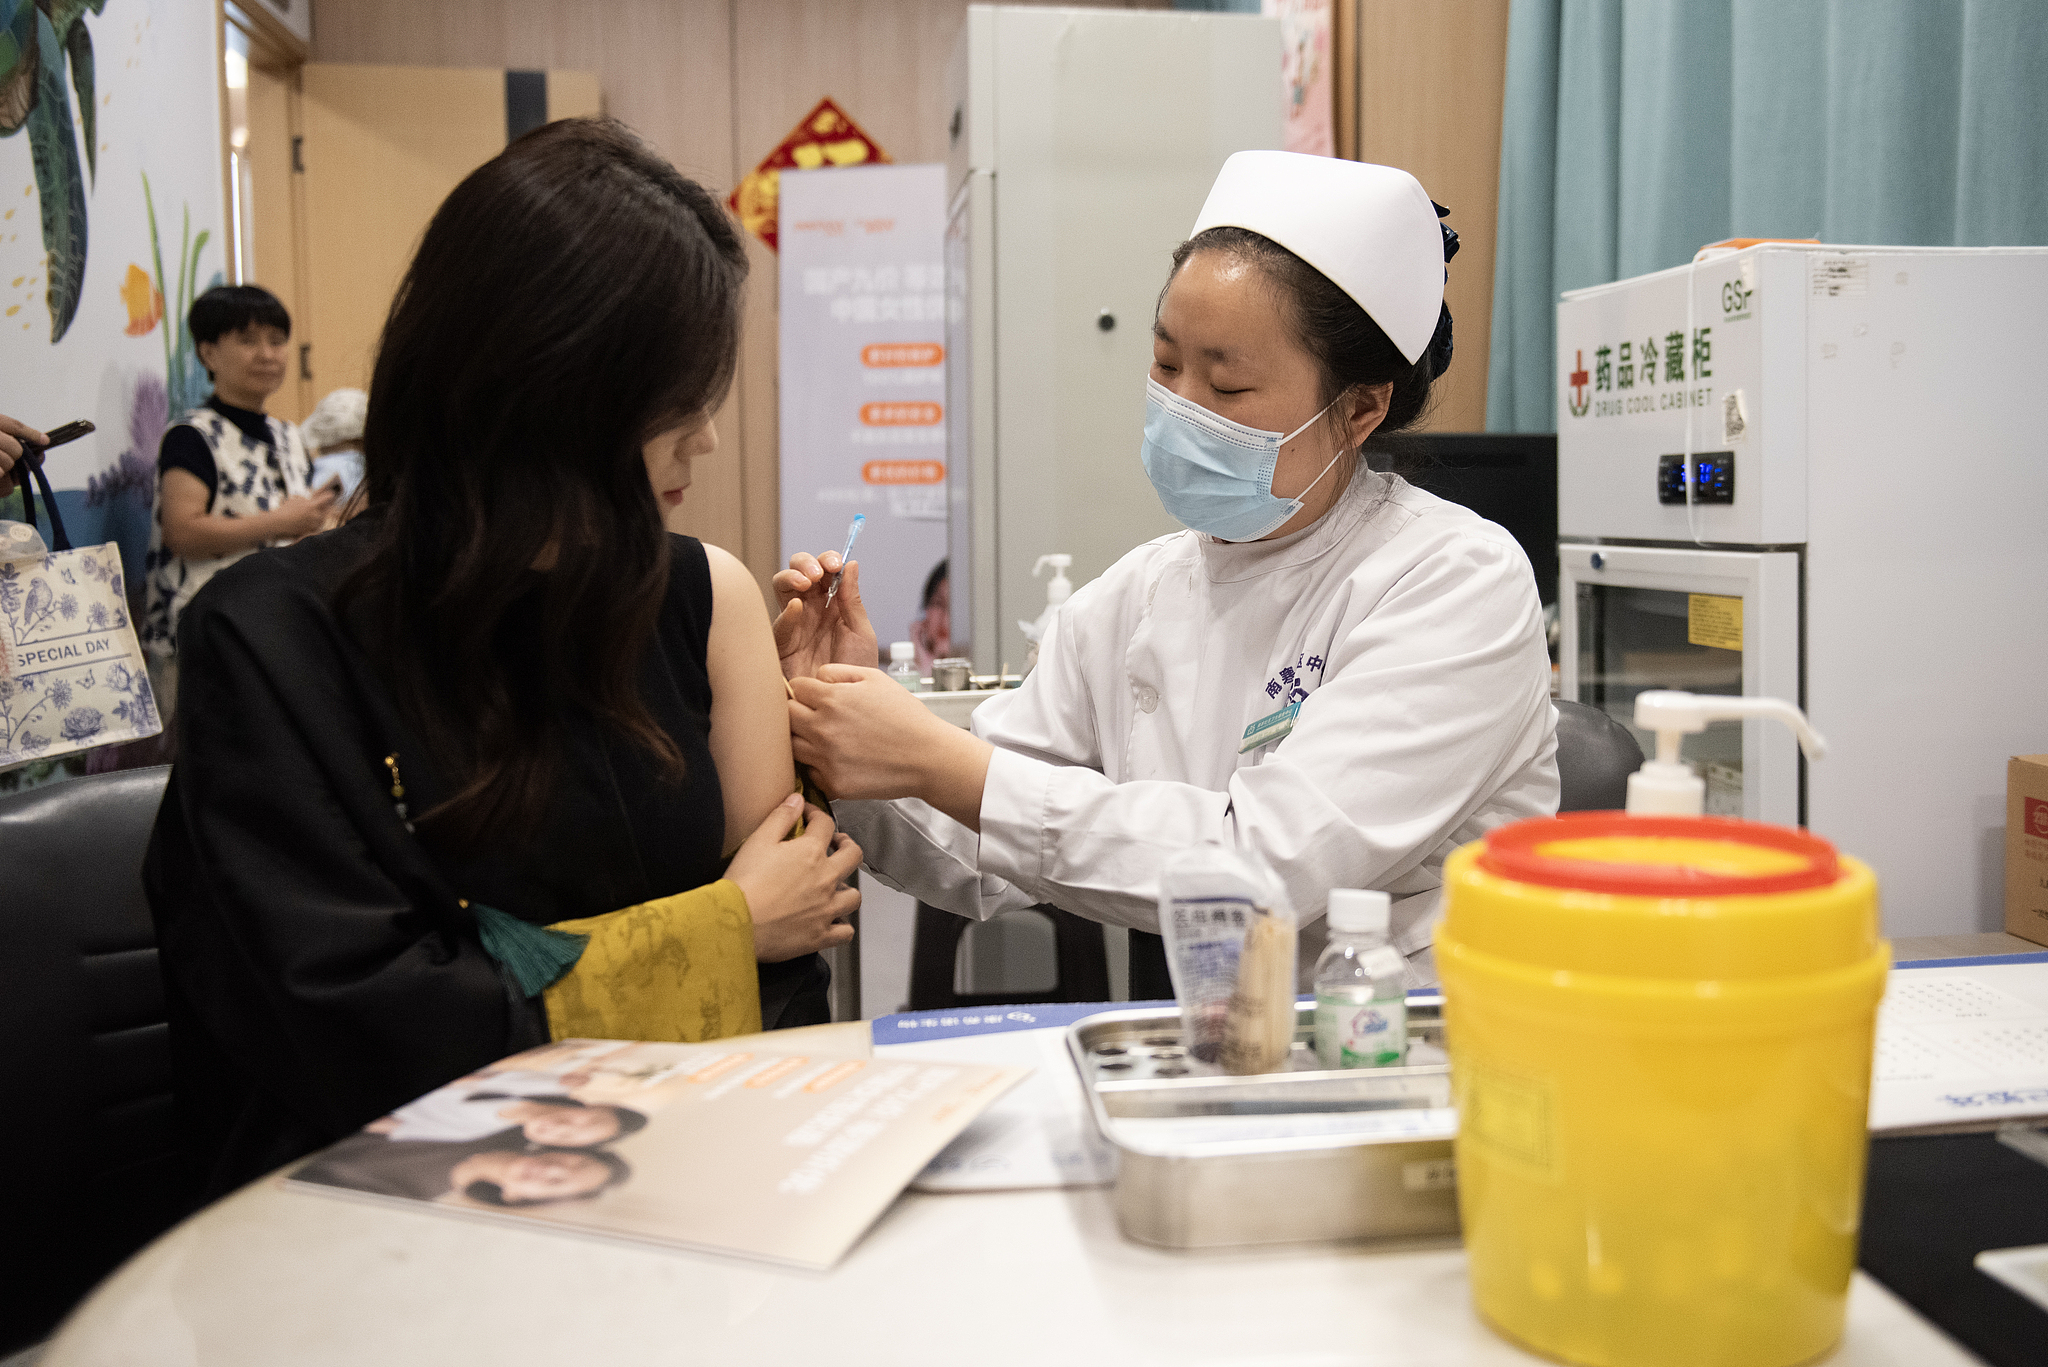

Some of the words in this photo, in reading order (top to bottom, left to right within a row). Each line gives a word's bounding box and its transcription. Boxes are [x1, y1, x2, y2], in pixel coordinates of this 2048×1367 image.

[1595, 327, 1713, 393] 药品冷藏柜
[1595, 398, 1622, 418] DRUG
[1626, 395, 1656, 414] COOL
[1660, 387, 1713, 411] CABINET
[17, 644, 82, 668] SPECIAL
[85, 638, 110, 655] DAY
